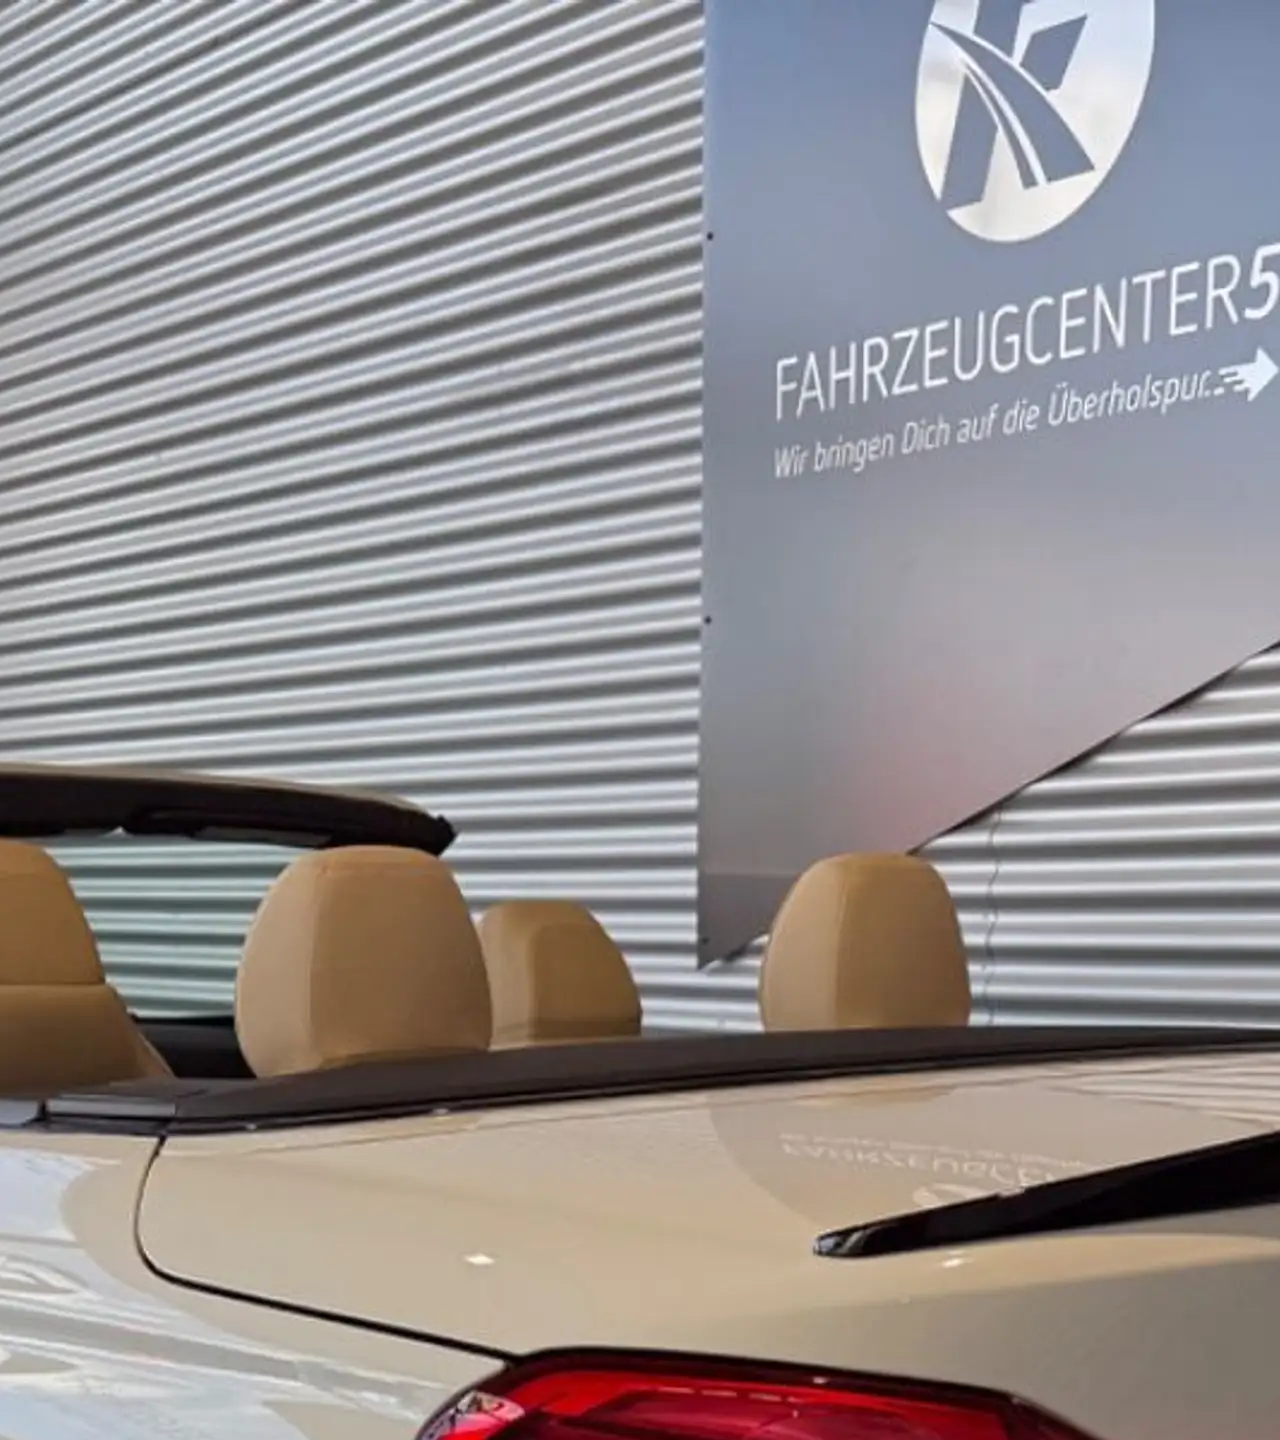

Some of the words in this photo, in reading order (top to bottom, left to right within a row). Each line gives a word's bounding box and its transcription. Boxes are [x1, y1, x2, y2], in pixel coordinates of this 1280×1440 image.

[774, 443, 810, 479] Wir
[813, 433, 895, 474] bringen
[900, 414, 951, 455] Dich
[956, 403, 999, 443] auf
[1002, 398, 1040, 436] die
